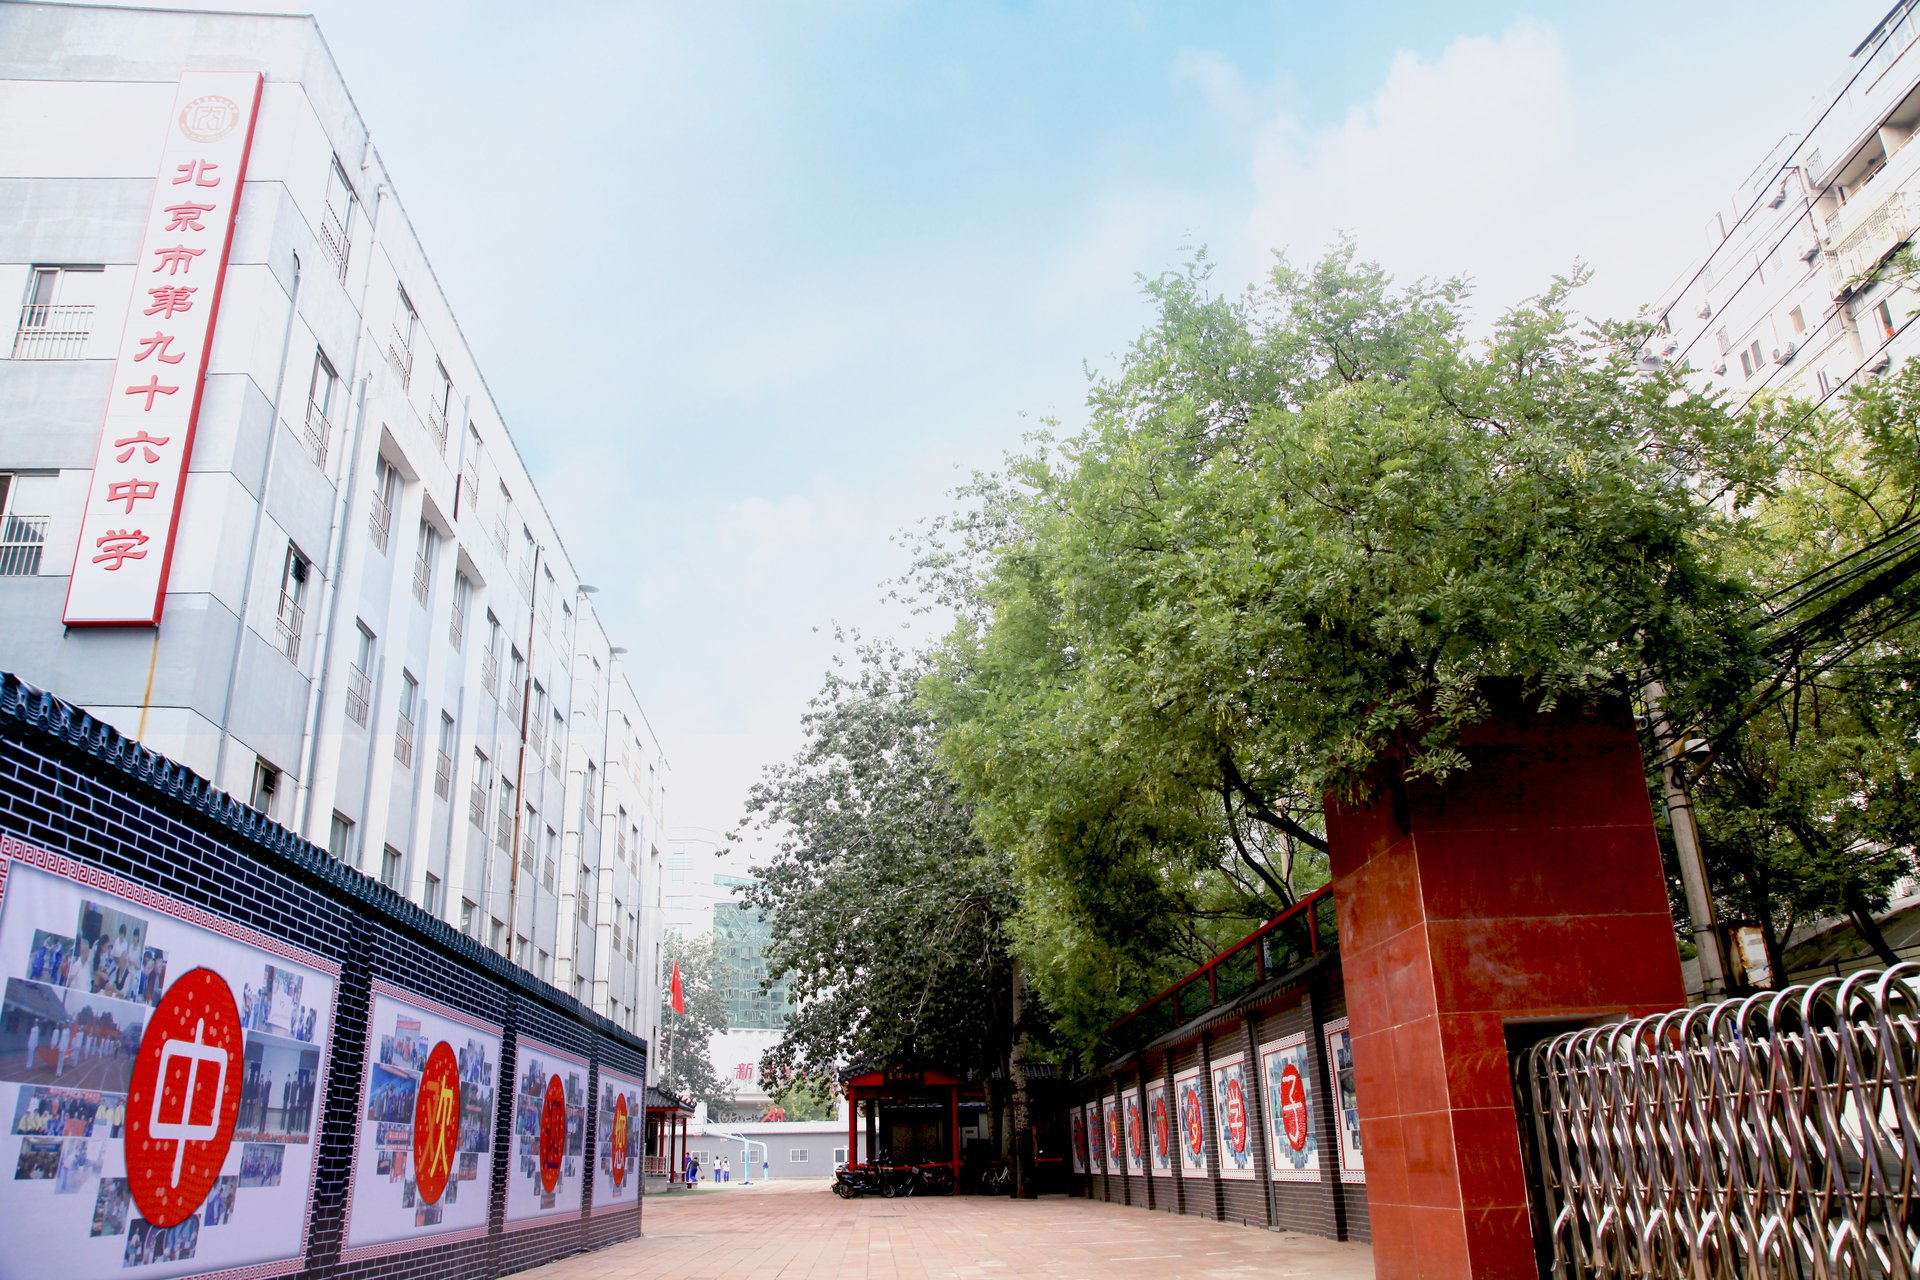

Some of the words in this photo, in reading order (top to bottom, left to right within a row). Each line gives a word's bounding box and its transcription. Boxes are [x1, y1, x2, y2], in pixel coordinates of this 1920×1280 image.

[92, 160, 221, 572] 北京市第九十六中学
[148, 1018, 229, 1189] 中
[733, 1062, 754, 1080] 新
[1282, 1074, 1303, 1143] 子
[418, 1074, 454, 1178] 欢
[1228, 1087, 1243, 1144] 学
